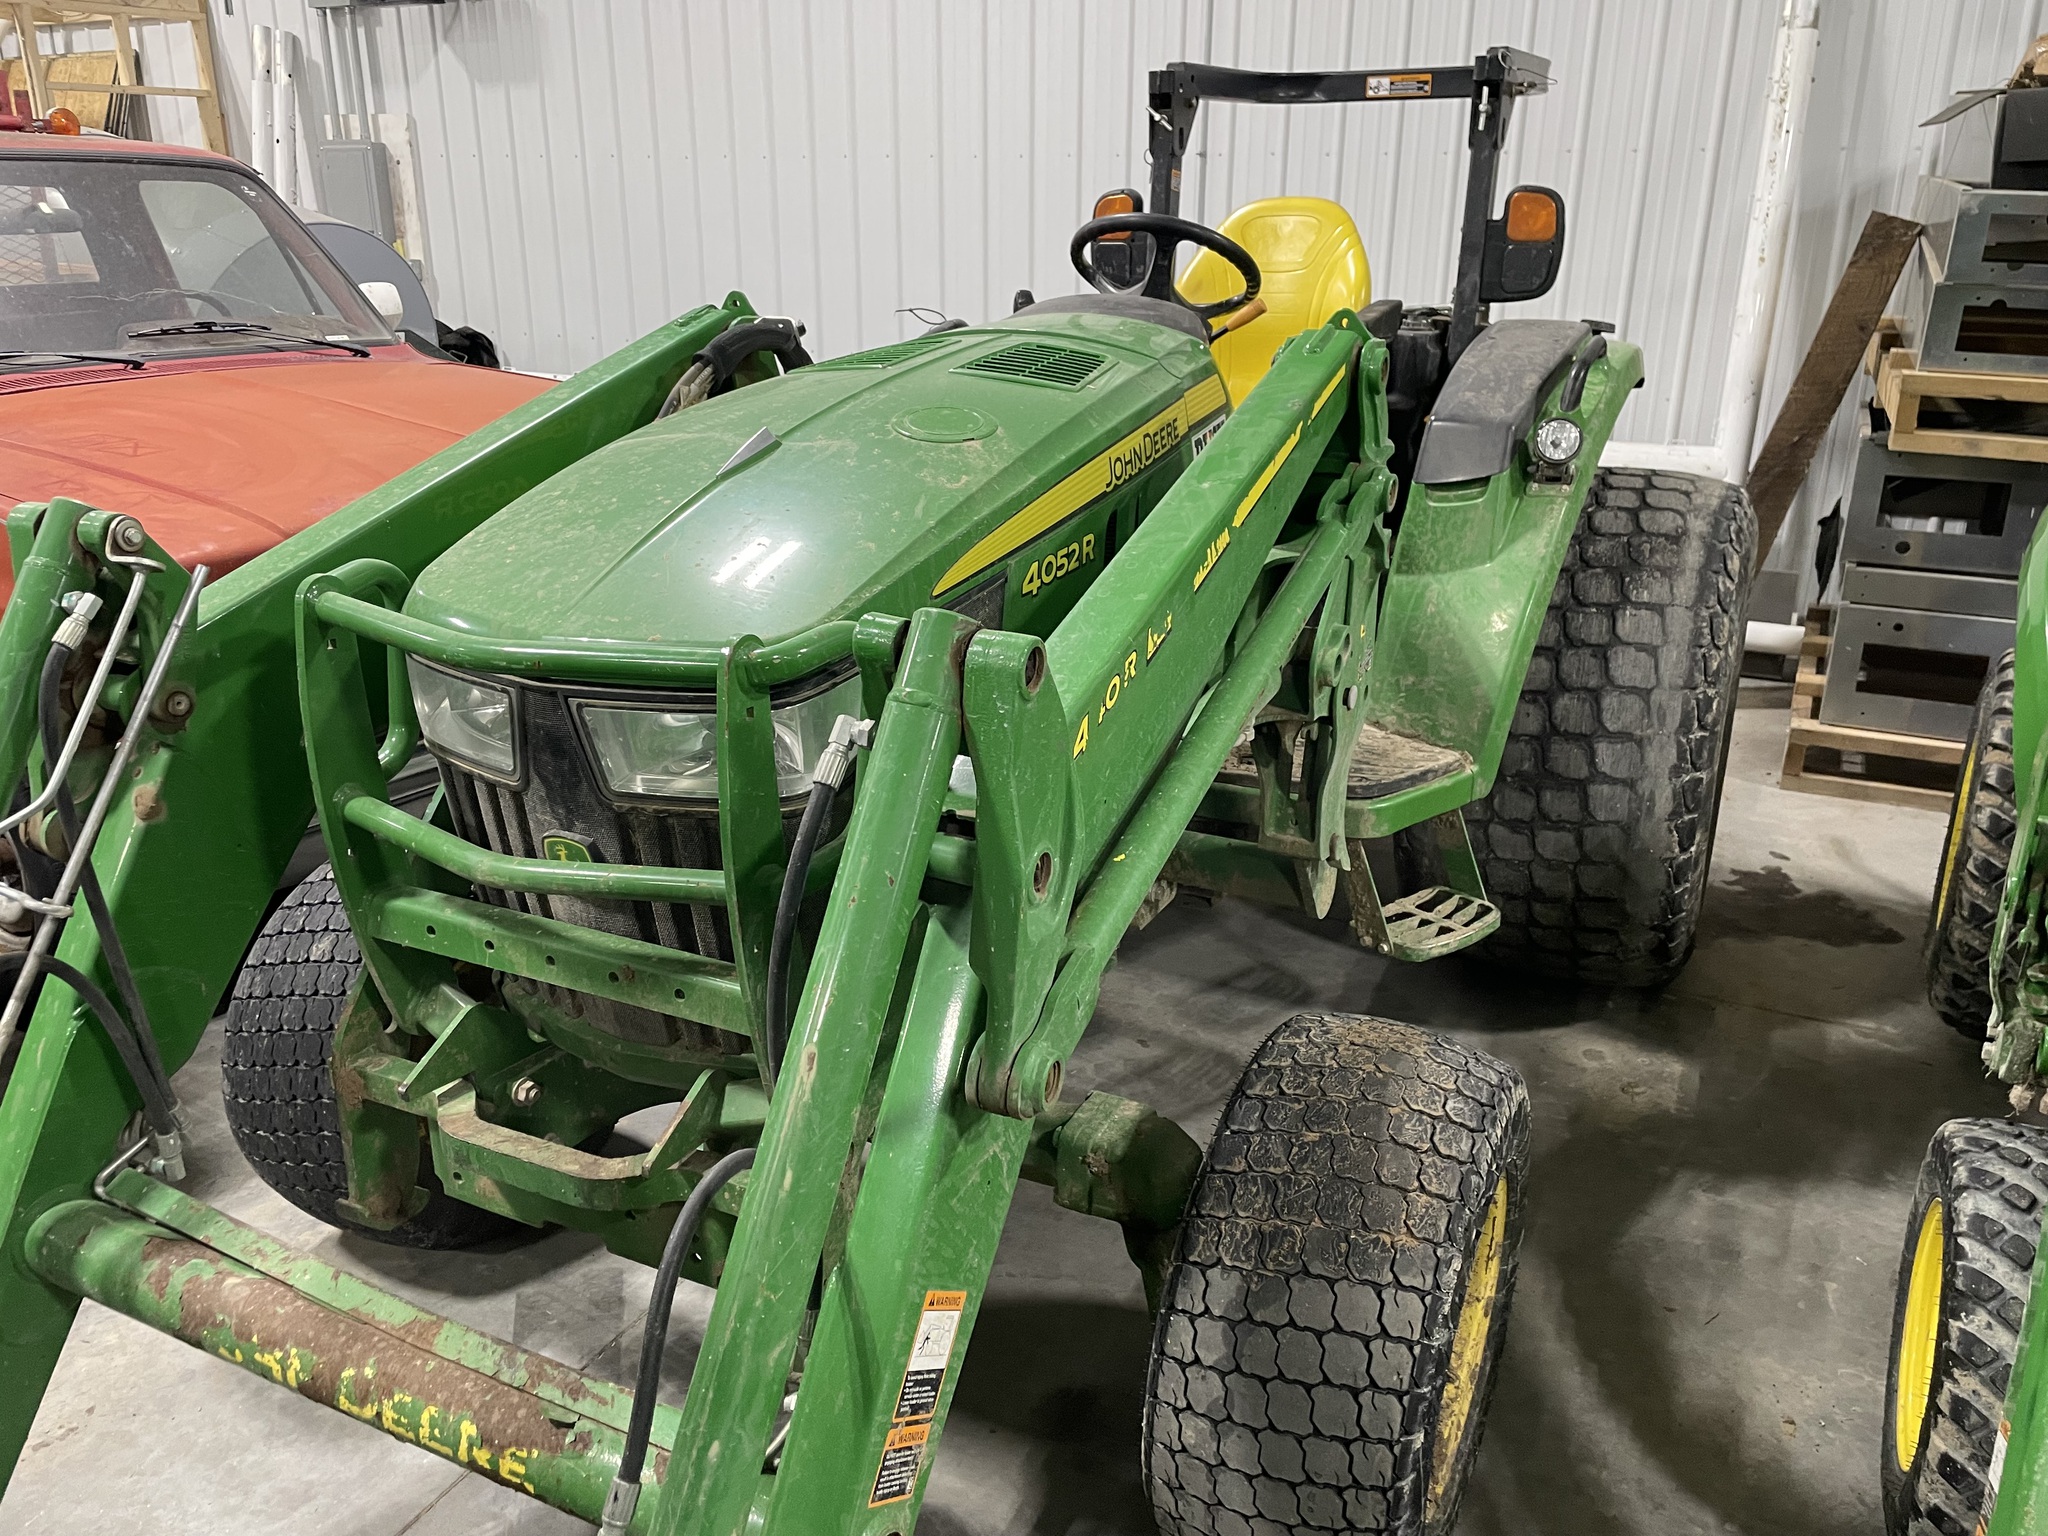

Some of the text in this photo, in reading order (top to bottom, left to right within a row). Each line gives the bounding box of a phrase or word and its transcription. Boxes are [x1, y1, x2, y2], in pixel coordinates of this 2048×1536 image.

[1105, 442, 1143, 491] JOHN
[1142, 416, 1180, 463] DEERE
[1022, 533, 1095, 597] 4052R
[935, 1296, 961, 1307] WARNING
[899, 1430, 925, 1444] WARNING
